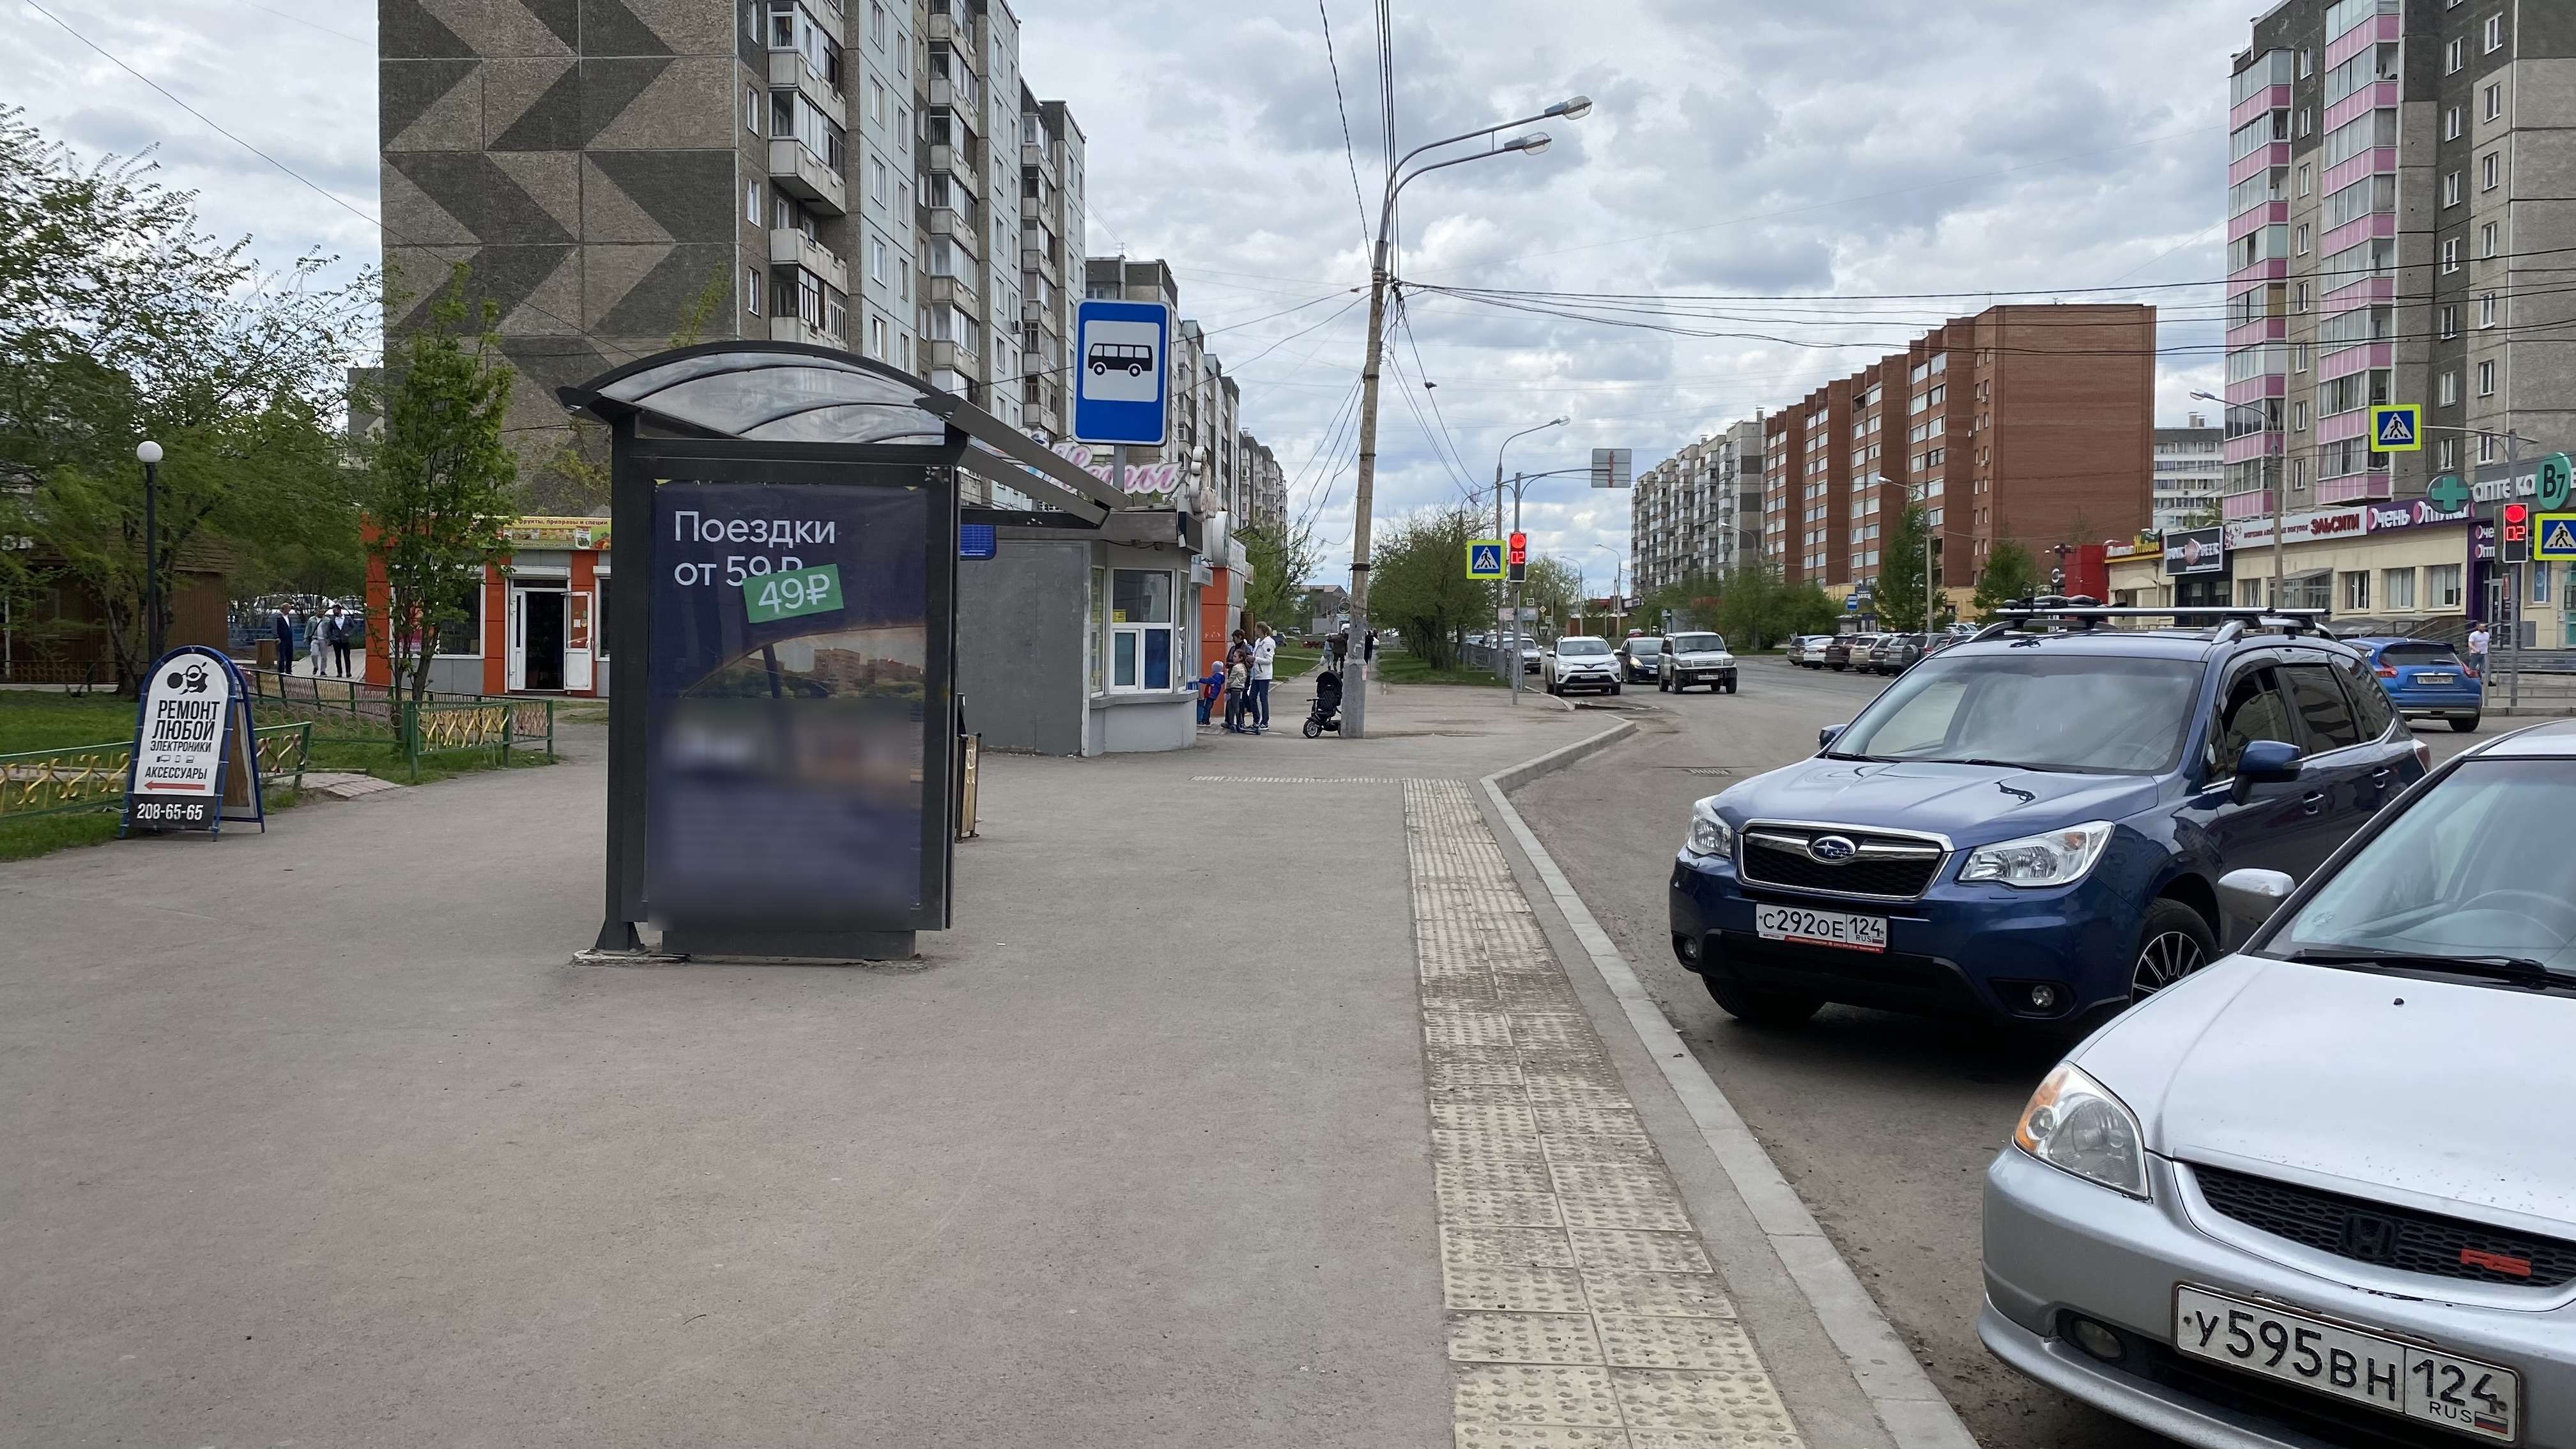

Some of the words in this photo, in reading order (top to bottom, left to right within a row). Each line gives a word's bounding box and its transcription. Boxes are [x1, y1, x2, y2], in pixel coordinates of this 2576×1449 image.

[2543, 464, 2566, 498] B7
[675, 510, 836, 548] Поездки
[2367, 508, 2411, 530] Очень
[2506, 525, 2526, 541] 02
[1510, 551, 1525, 564] 02
[674, 563, 717, 586] от
[758, 574, 830, 614] 49₽
[157, 700, 220, 720] РЕМОНТ
[151, 718, 215, 741] ЛЮБОЙ
[150, 740, 212, 753] ЭЛЕКТРОНИКИ
[144, 766, 208, 779] АКСЕССУАРЫ
[136, 802, 204, 821] 208-65-65
[1763, 909, 1844, 939] С292ОЕ
[1849, 917, 1881, 937] 124
[1855, 935, 1872, 943] RUS
[2195, 1310, 2396, 1402] У595ВН
[2412, 1358, 2498, 1414] 124
[2428, 1402, 2472, 1424] RUS
